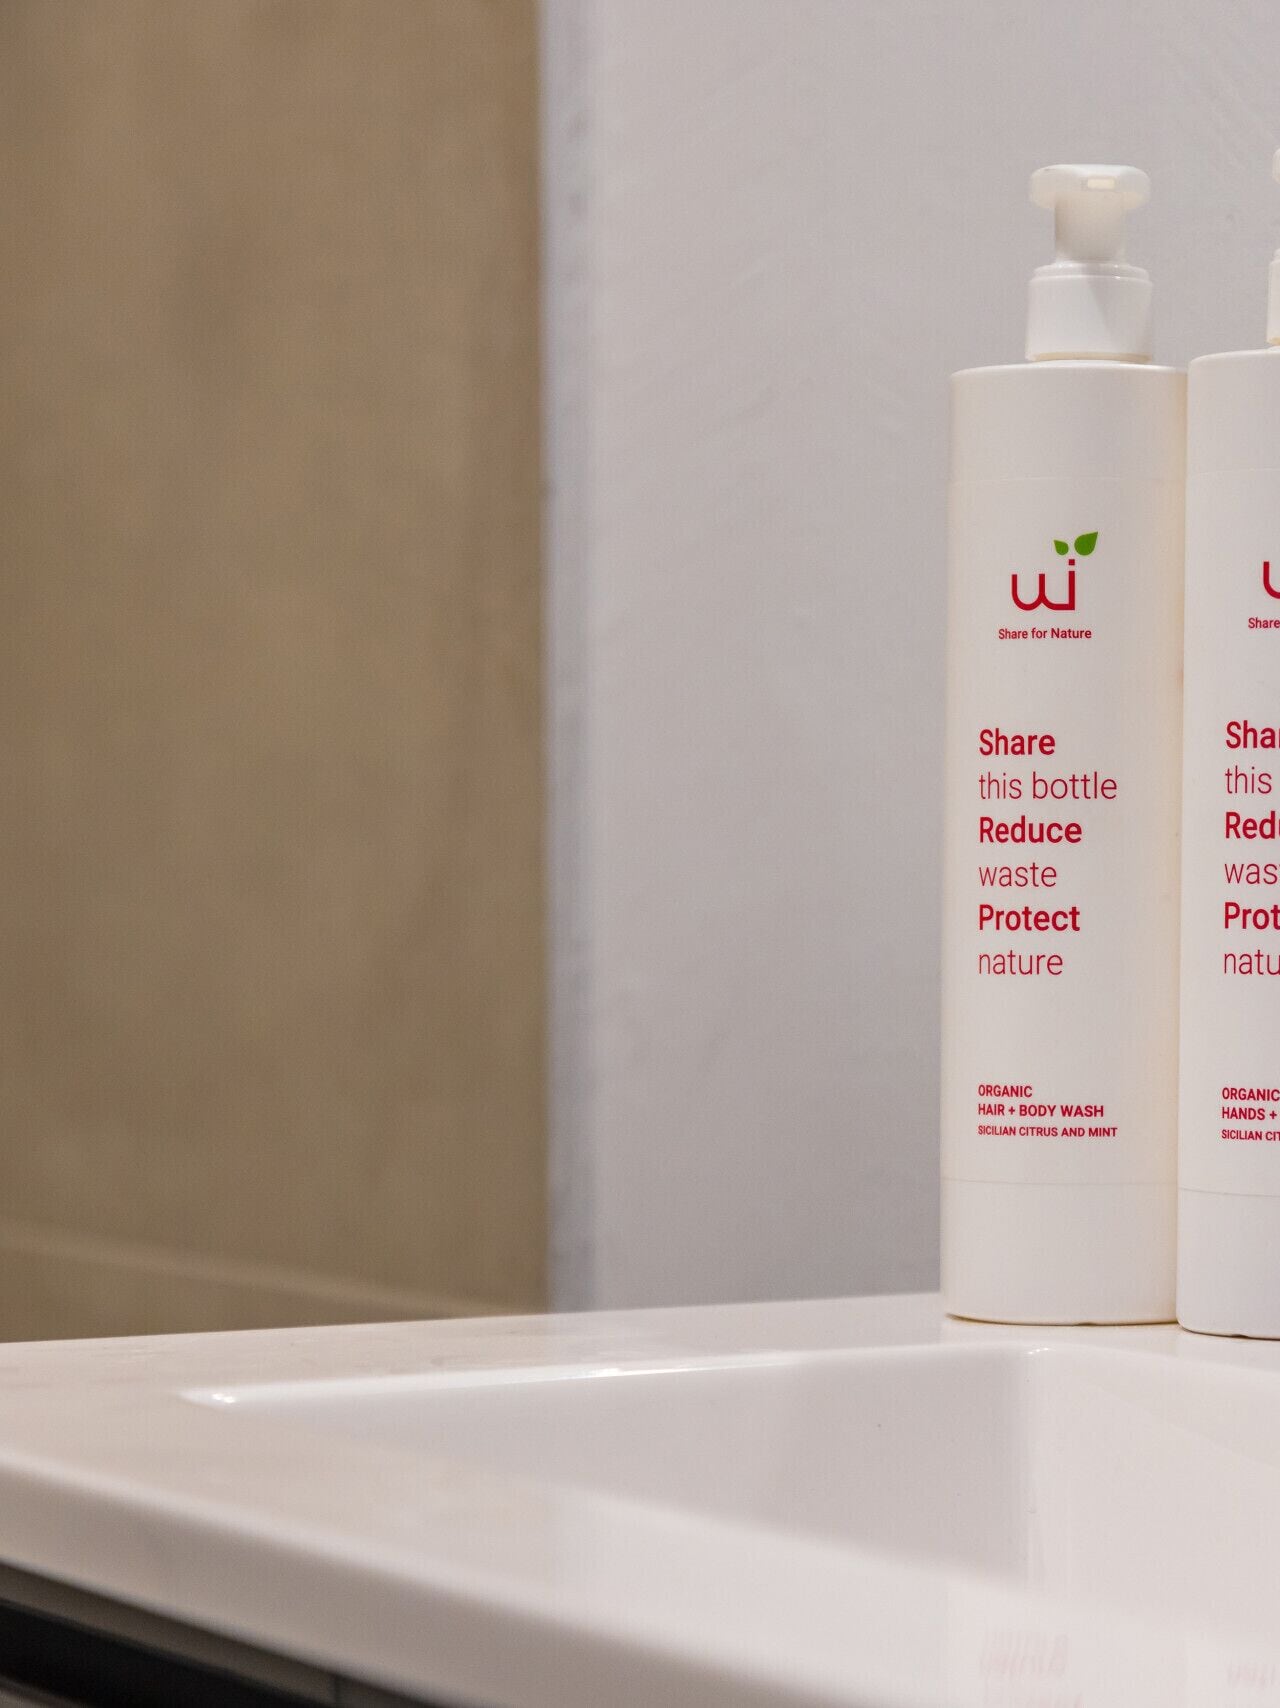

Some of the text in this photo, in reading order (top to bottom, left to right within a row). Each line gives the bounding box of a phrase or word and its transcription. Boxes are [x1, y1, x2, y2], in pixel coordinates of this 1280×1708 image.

[1248, 616, 1280, 629] Share
[998, 627, 1093, 640] Share for Nature
[978, 728, 1056, 757] Share
[978, 771, 1118, 800] this bottle
[1224, 766, 1273, 795] this
[978, 815, 1083, 845] Reduce
[978, 863, 1057, 888] waste
[977, 903, 1081, 932] Protect
[977, 951, 1064, 976] nature
[977, 1084, 1033, 1098] ORGANIC
[1221, 1087, 1280, 1102] ORGANIC
[977, 1103, 1005, 1116] HAIR
[1019, 1104, 1057, 1117] BODY
[1060, 1105, 1104, 1118] WASH
[1221, 1106, 1266, 1121] HANDS
[977, 1125, 1118, 1138] SICILIAN CITRUS AND MINT
[1221, 1129, 1262, 1141] SICILIAN
